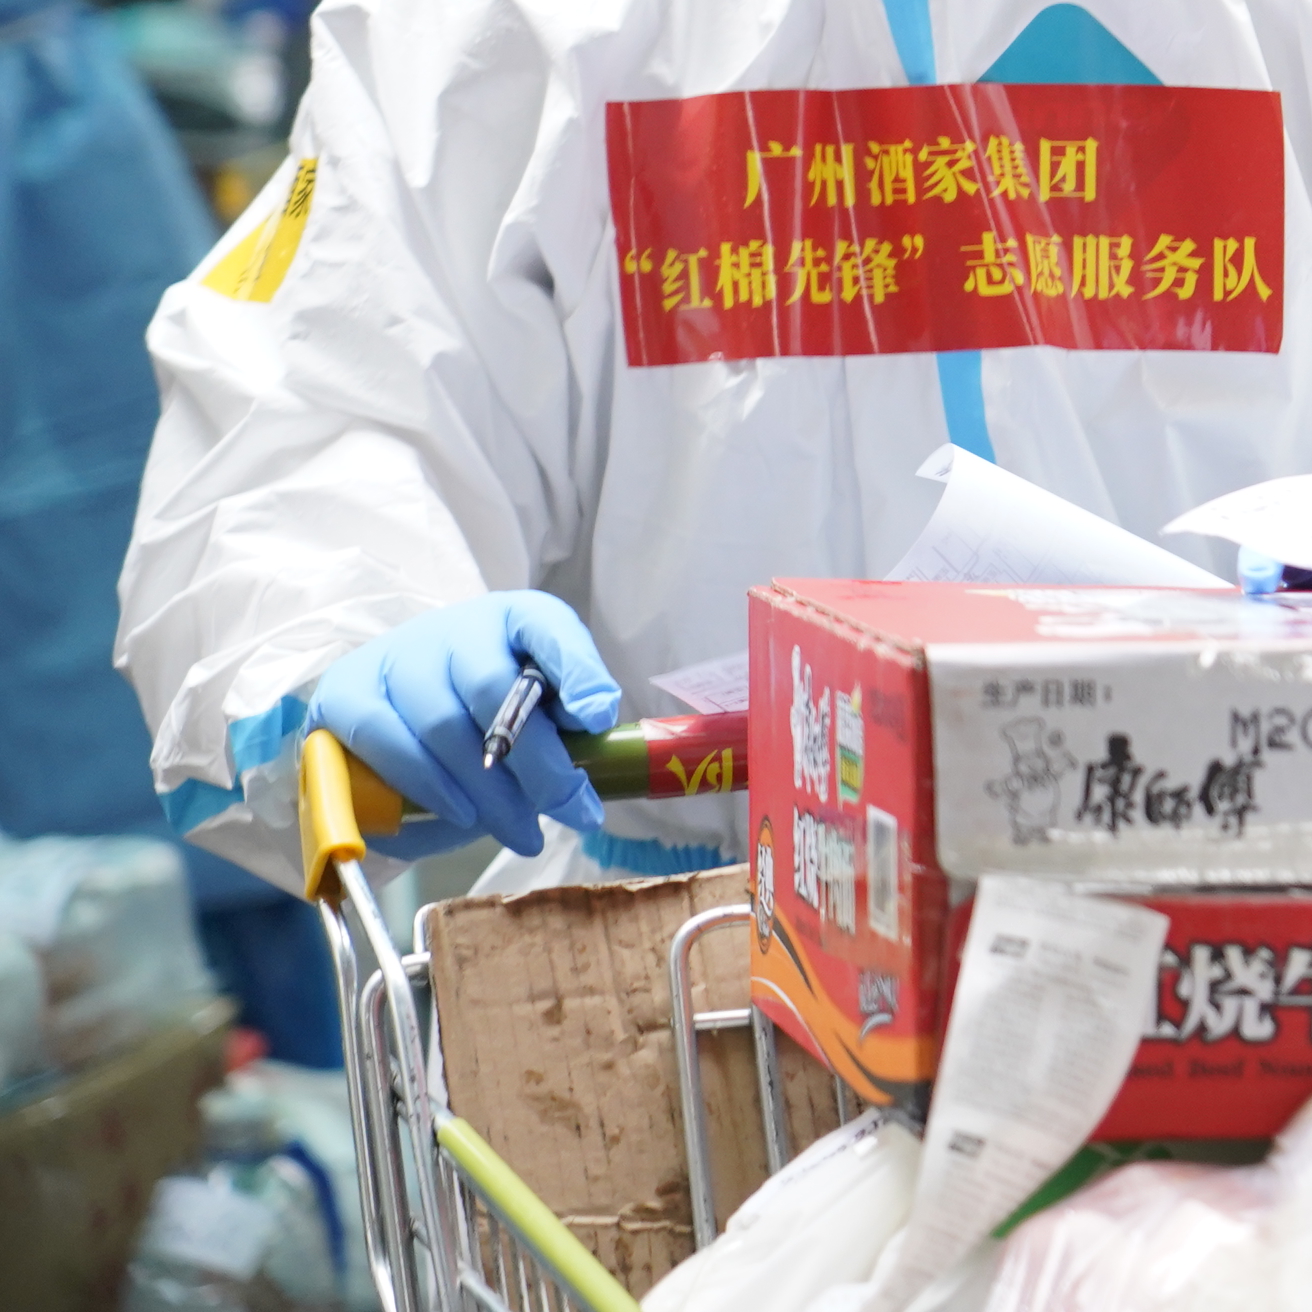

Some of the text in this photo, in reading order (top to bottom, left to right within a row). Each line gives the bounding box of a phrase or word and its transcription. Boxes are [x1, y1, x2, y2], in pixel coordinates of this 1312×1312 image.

[743, 135, 1100, 210] 广州酒家集团
